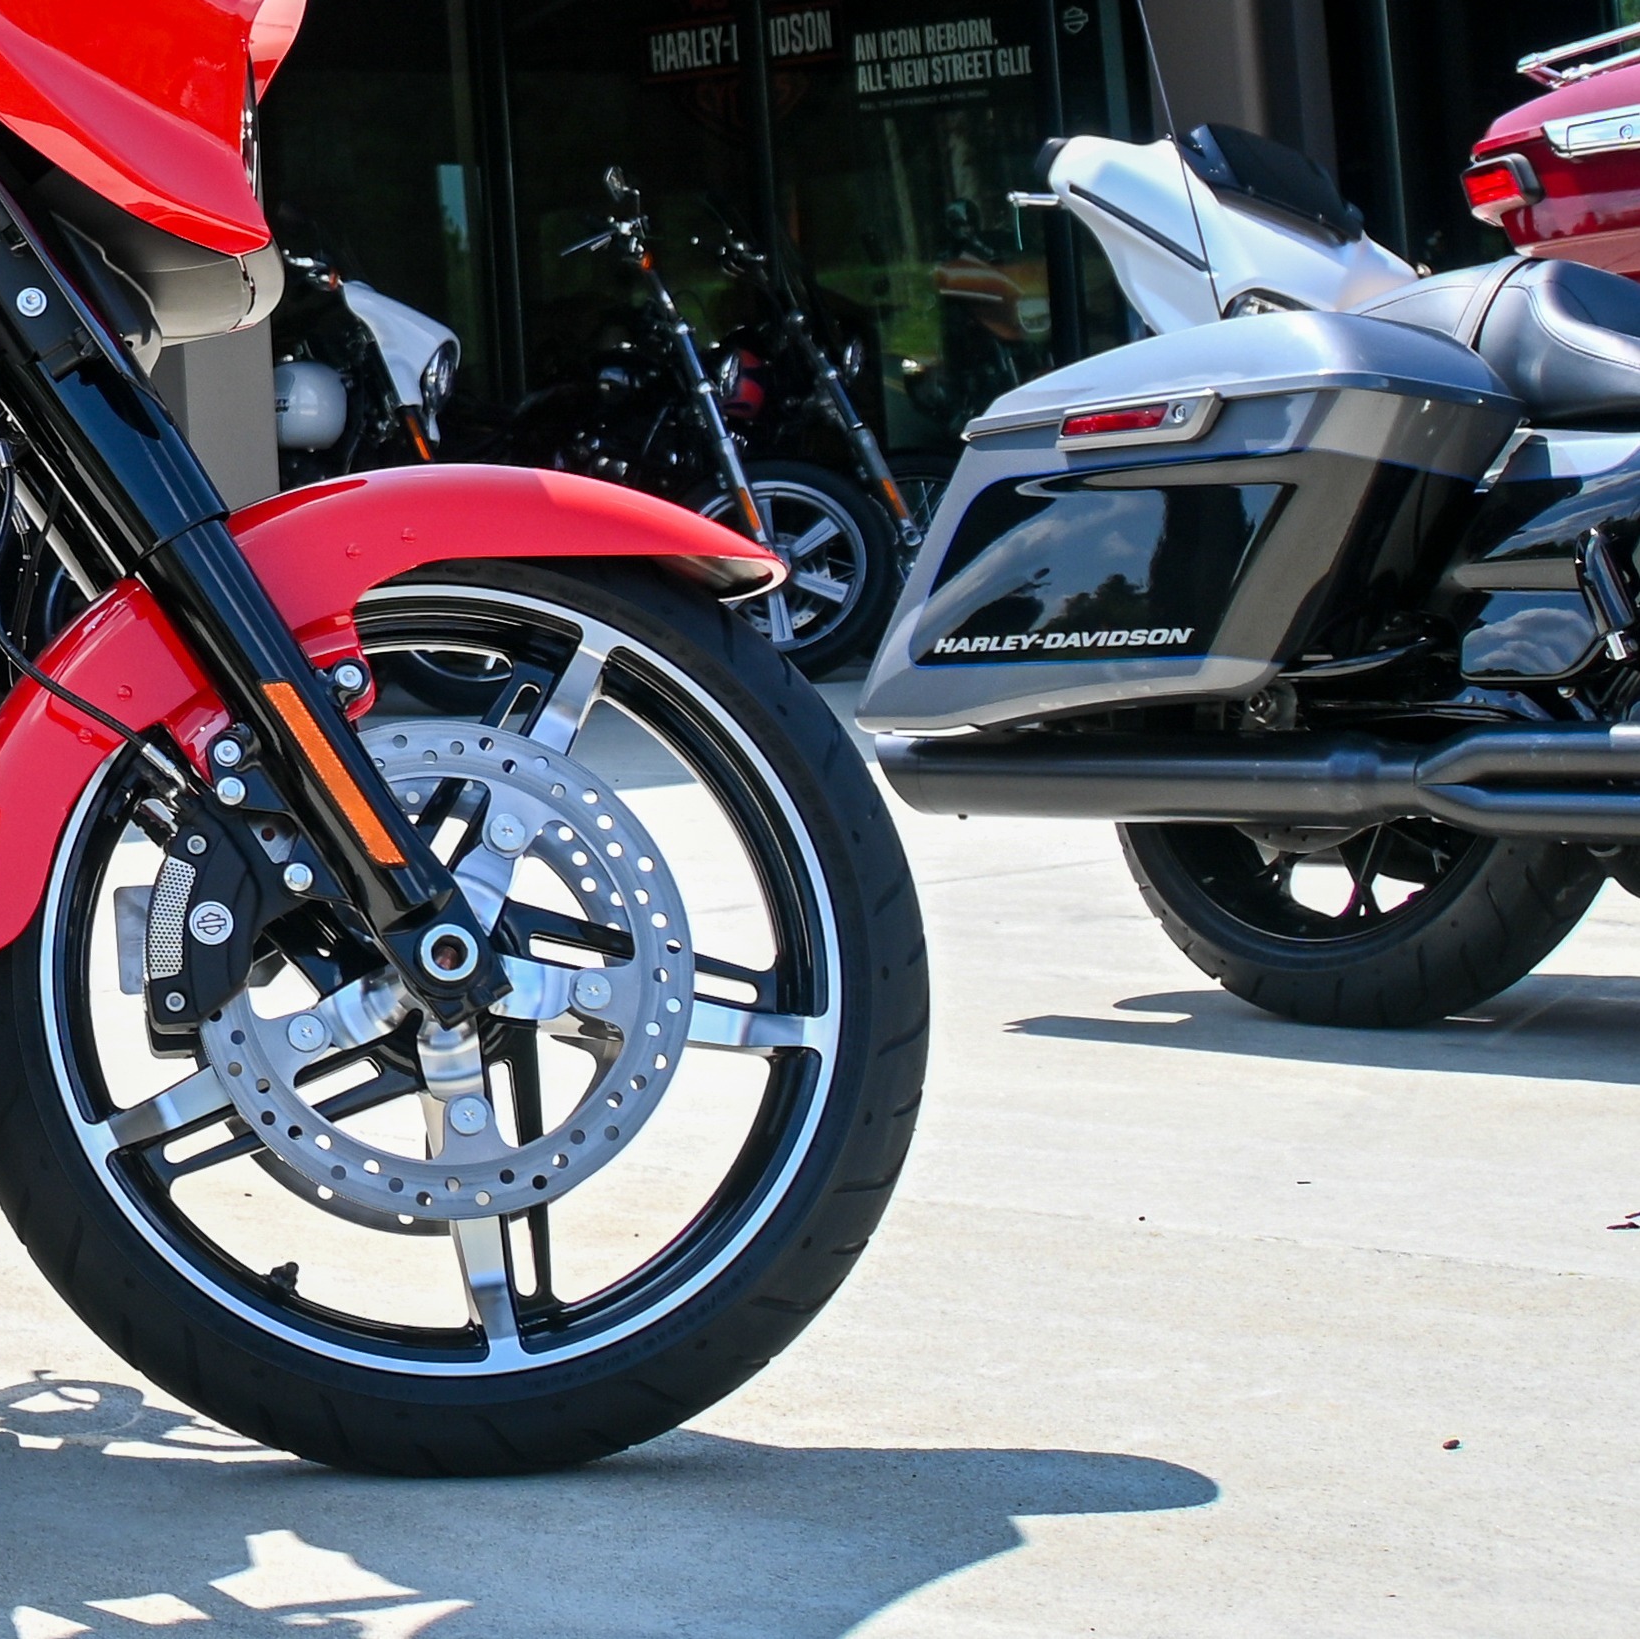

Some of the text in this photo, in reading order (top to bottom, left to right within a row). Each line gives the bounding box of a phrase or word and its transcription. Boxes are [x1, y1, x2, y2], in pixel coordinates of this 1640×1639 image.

[854, 17, 999, 62] AN ICON REBORN.
[857, 58, 930, 94] ALL-NEW
[931, 50, 993, 85] STREET
[933, 627, 1194, 654] HARLEY-DAVIDSON
